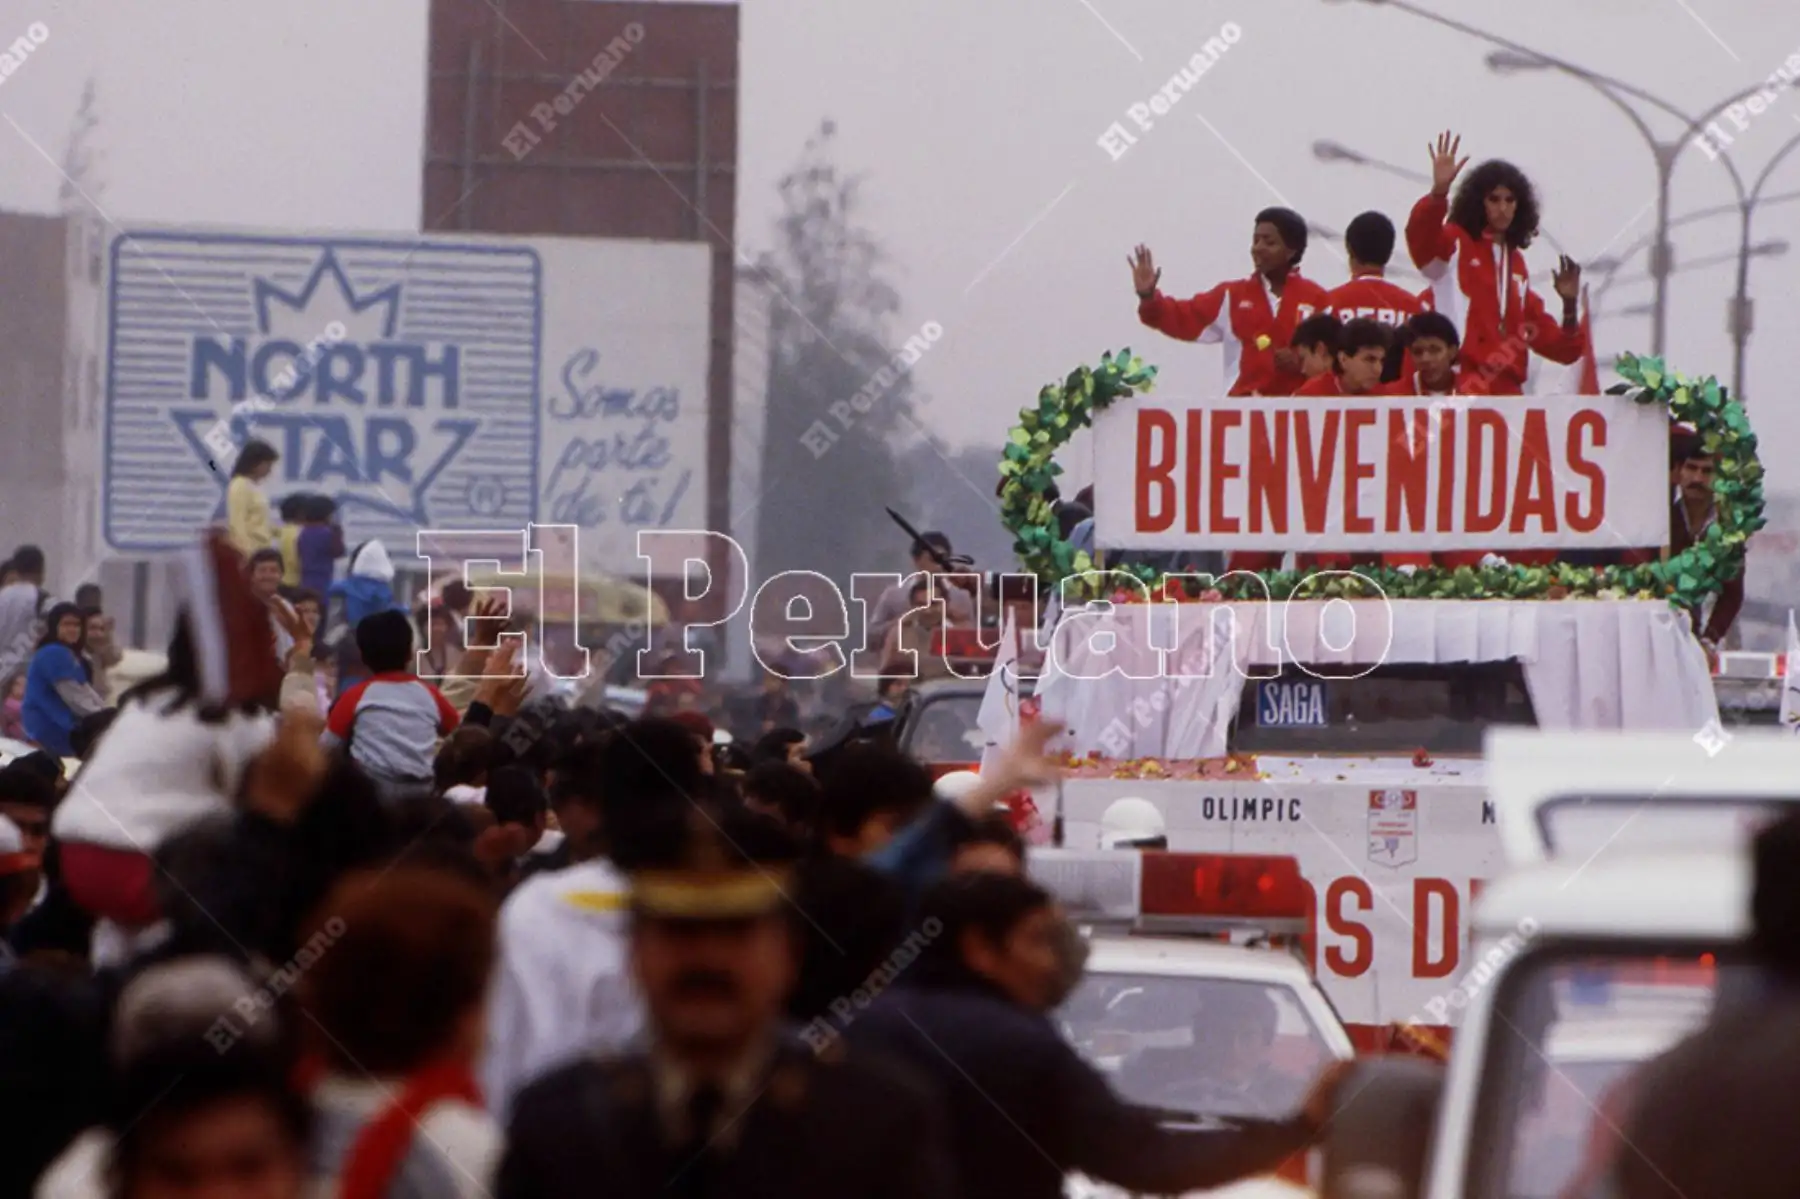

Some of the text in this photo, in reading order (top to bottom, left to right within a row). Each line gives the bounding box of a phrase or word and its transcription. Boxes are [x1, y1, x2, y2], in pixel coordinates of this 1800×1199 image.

[191, 336, 460, 409] NORTH
[1135, 408, 1607, 534] BIENVENIDAS
[1263, 682, 1324, 725] SAGA
[1202, 797, 1301, 822] OLIMPIC
[1302, 875, 1374, 978] S
